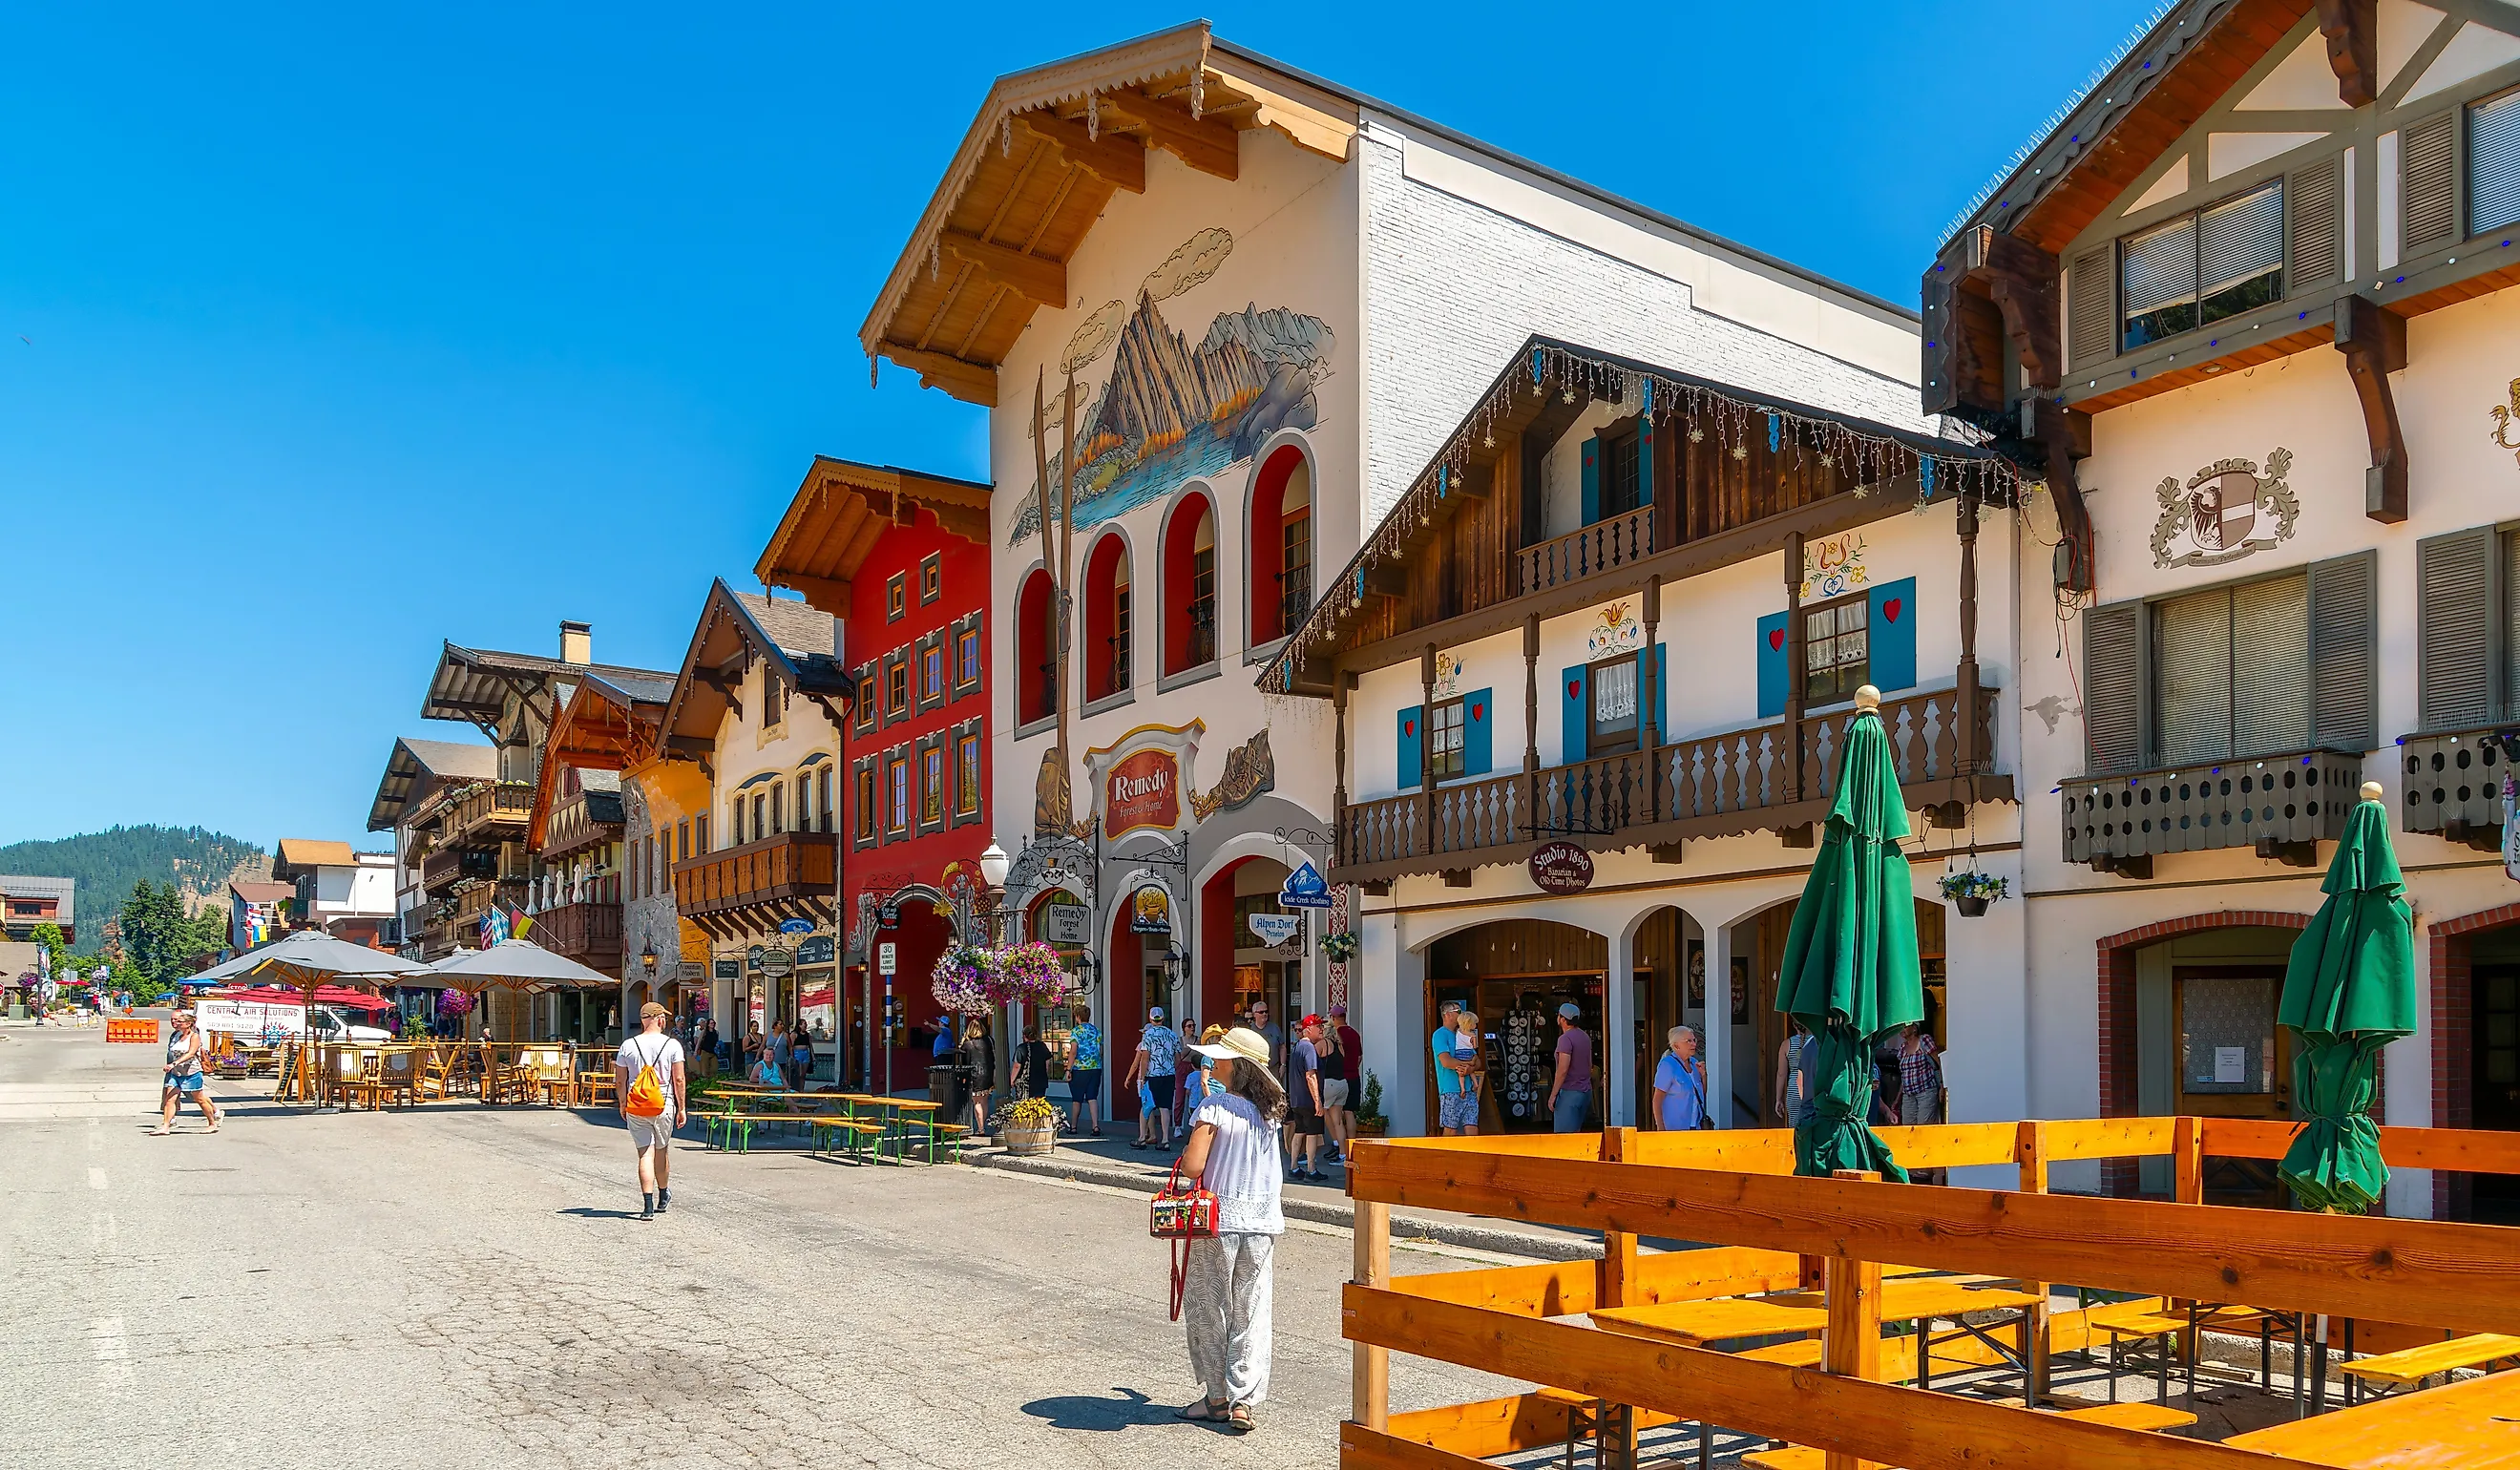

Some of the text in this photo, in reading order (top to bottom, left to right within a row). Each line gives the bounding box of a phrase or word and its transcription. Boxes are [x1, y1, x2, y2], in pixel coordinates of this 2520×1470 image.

[1115, 768, 1168, 803] Remedy
[1120, 805, 1138, 818] Forest
[1144, 801, 1163, 813] Home
[1534, 845, 1589, 872] Studio 1890
[1539, 875, 1586, 888] Old Time Photos
[1310, 896, 1330, 906] Clothing
[1052, 905, 1087, 922] Remedy
[1060, 919, 1080, 928] Forest
[1256, 917, 1294, 931] Alpen Dorf
[1060, 932, 1079, 940] Home
[1266, 929, 1286, 938] Pension
